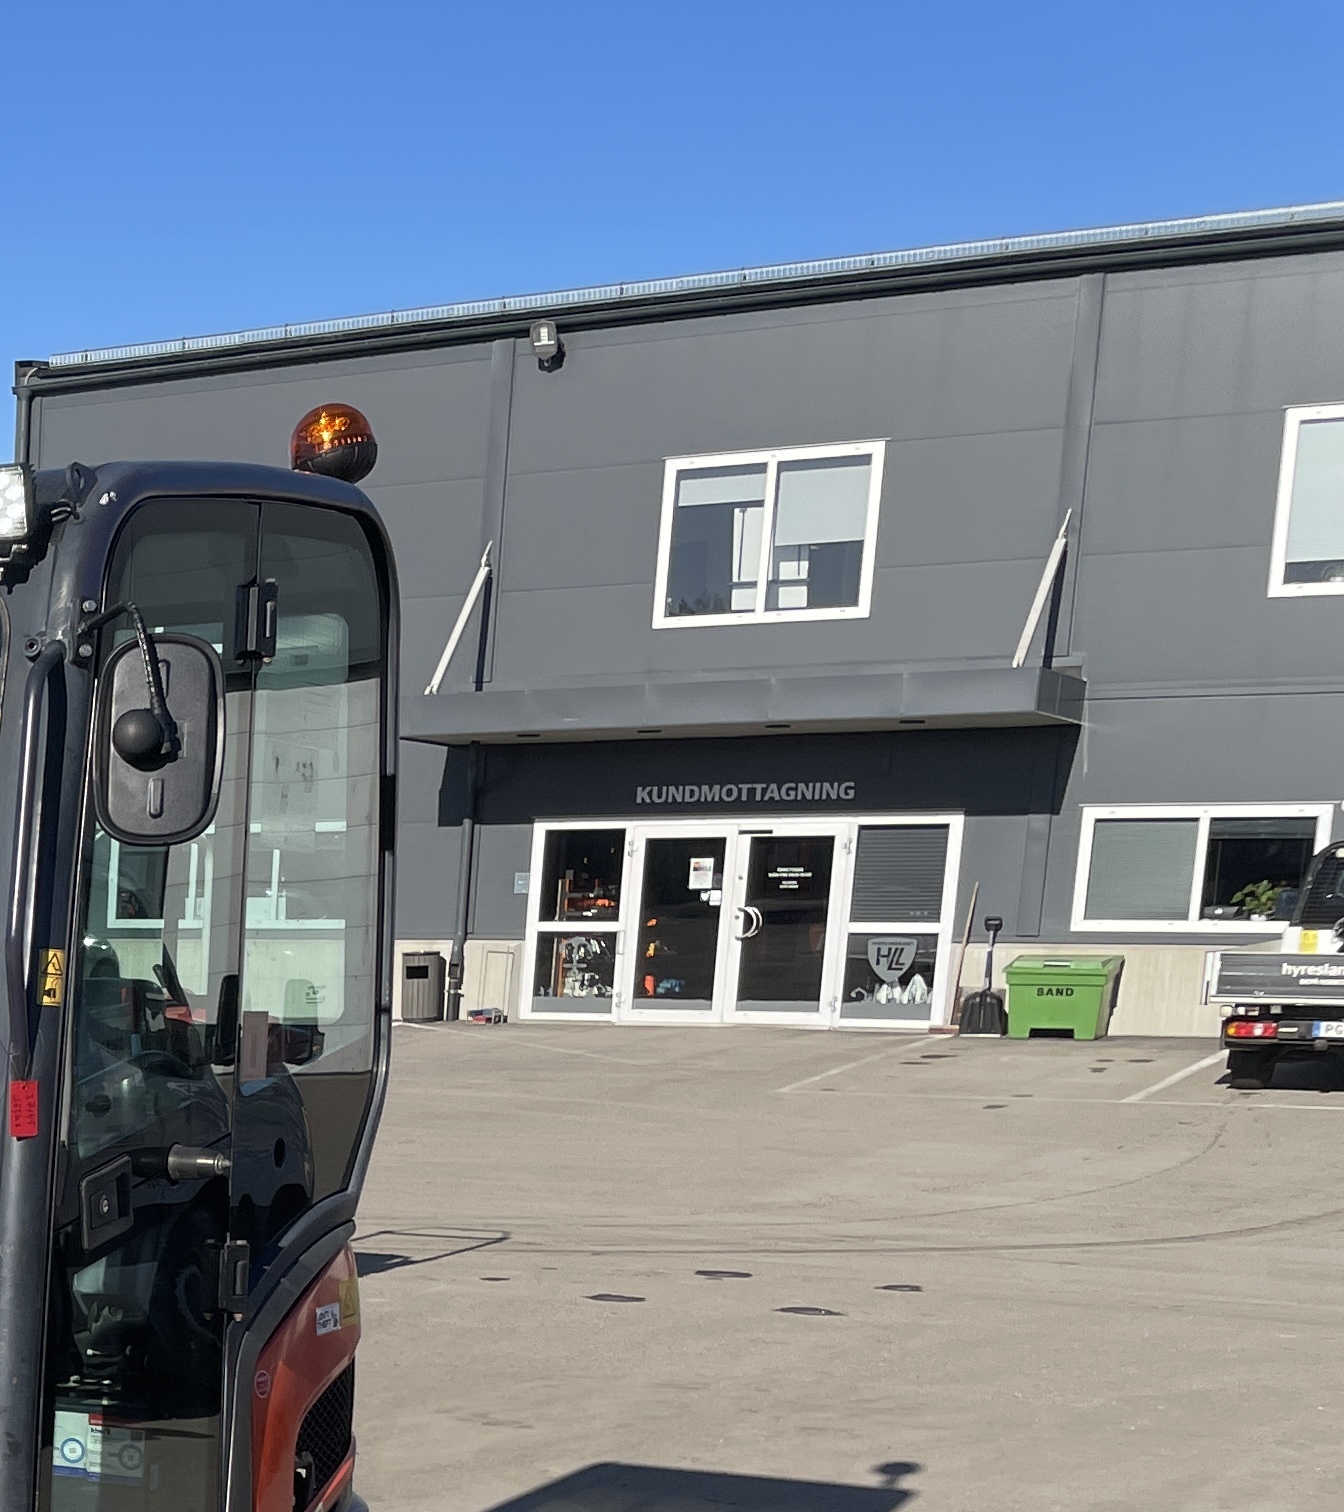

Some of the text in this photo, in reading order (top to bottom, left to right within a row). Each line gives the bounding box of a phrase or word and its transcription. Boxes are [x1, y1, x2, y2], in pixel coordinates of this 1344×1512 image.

[635, 781, 855, 803] KUNDMOTTAGNING
[876, 947, 906, 971] HLL
[1037, 987, 1074, 997] SAND
